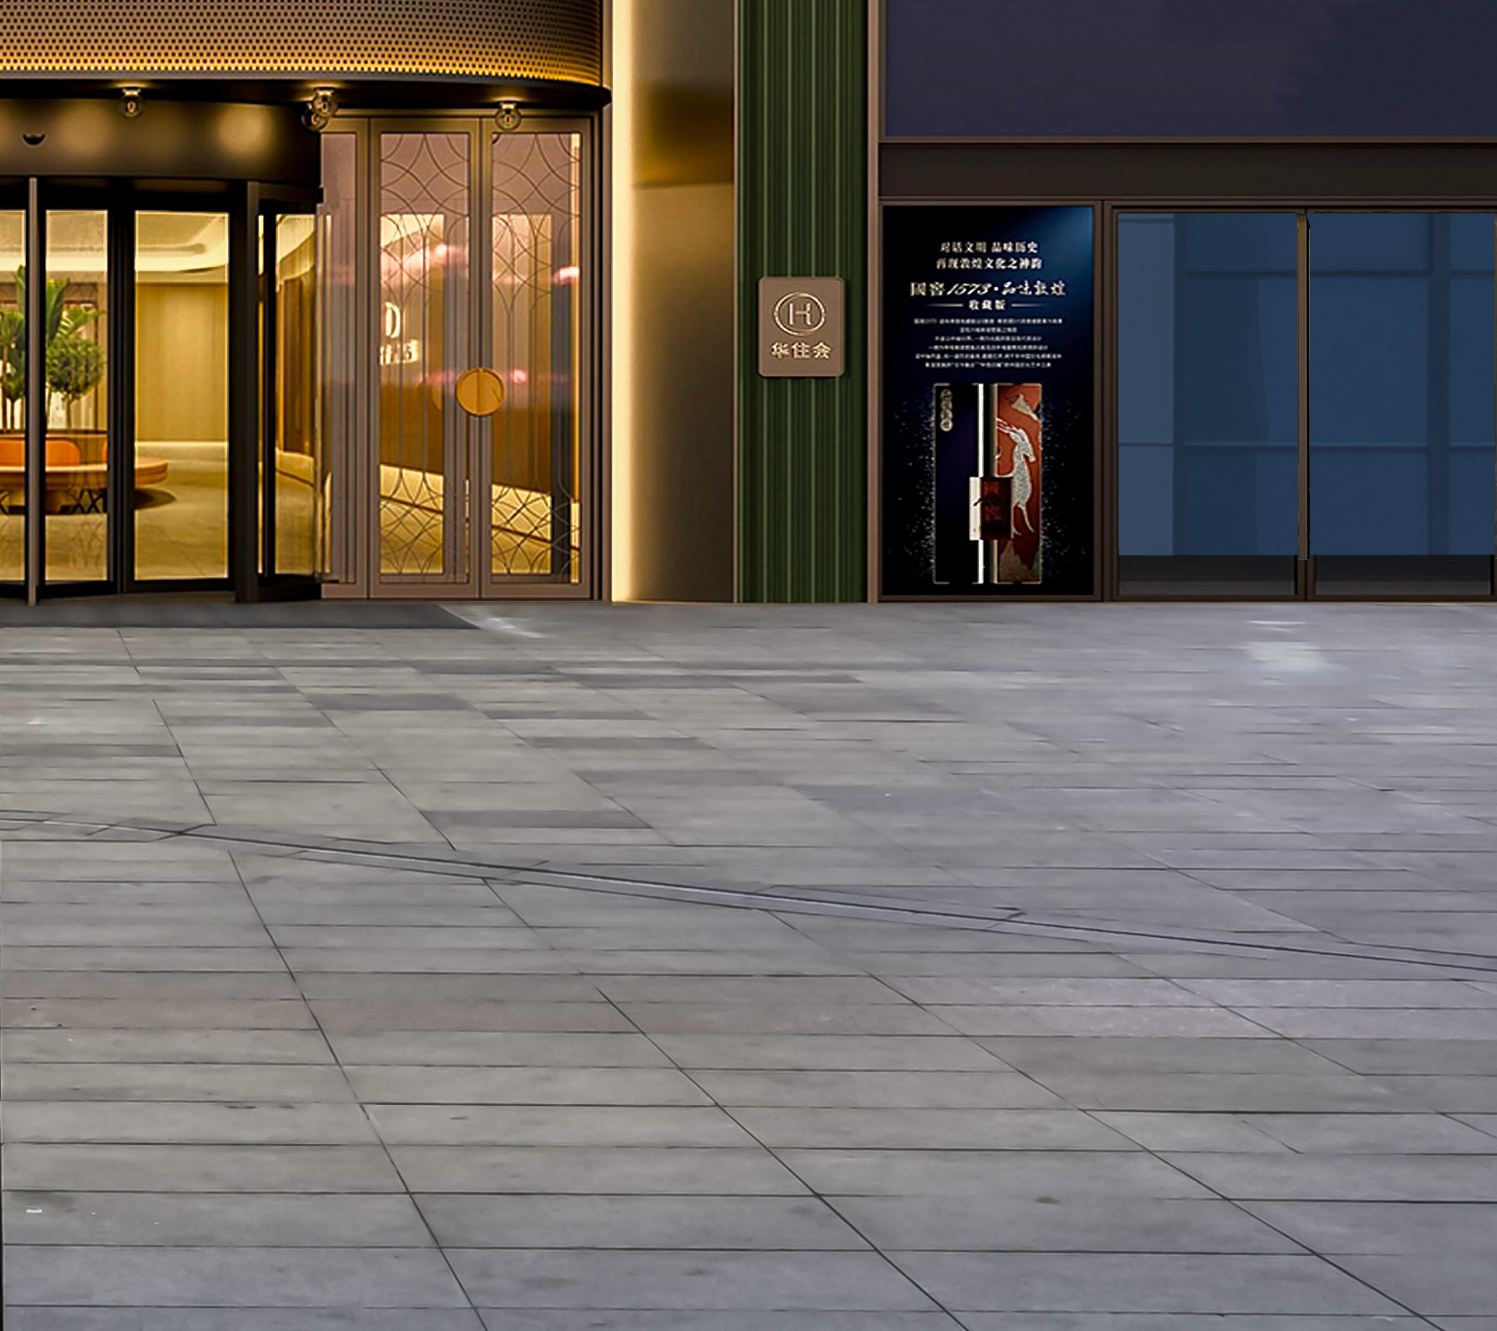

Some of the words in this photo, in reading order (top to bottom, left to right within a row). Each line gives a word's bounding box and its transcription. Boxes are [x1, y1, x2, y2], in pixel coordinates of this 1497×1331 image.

[968, 299, 1006, 311] 收藏版
[770, 341, 833, 360] 华住会
